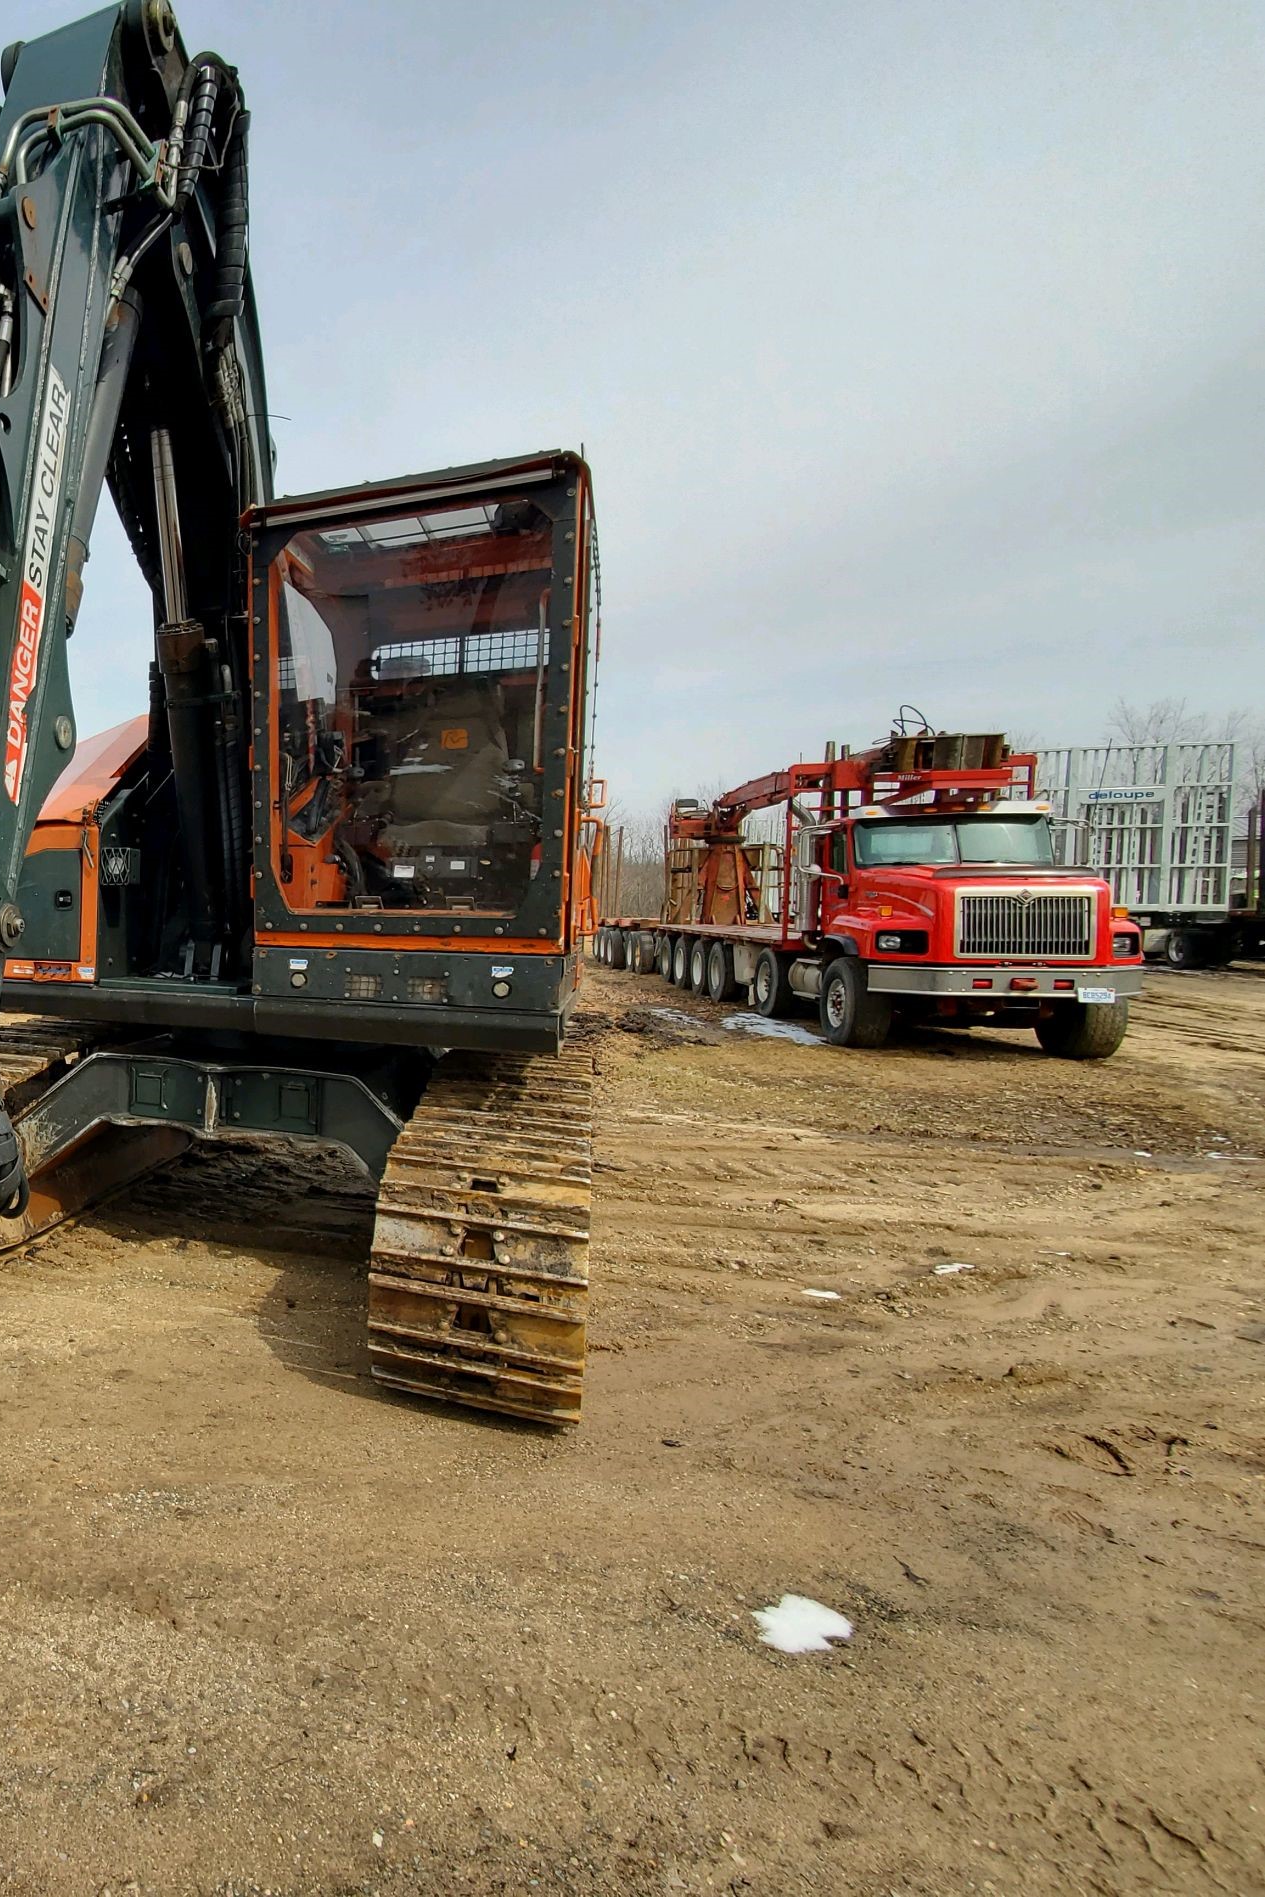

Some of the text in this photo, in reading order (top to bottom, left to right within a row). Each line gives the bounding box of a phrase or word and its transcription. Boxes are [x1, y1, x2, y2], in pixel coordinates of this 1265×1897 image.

[7, 384, 65, 747] DANGER STAY CLEAR
[1088, 791, 1155, 800] deloupe
